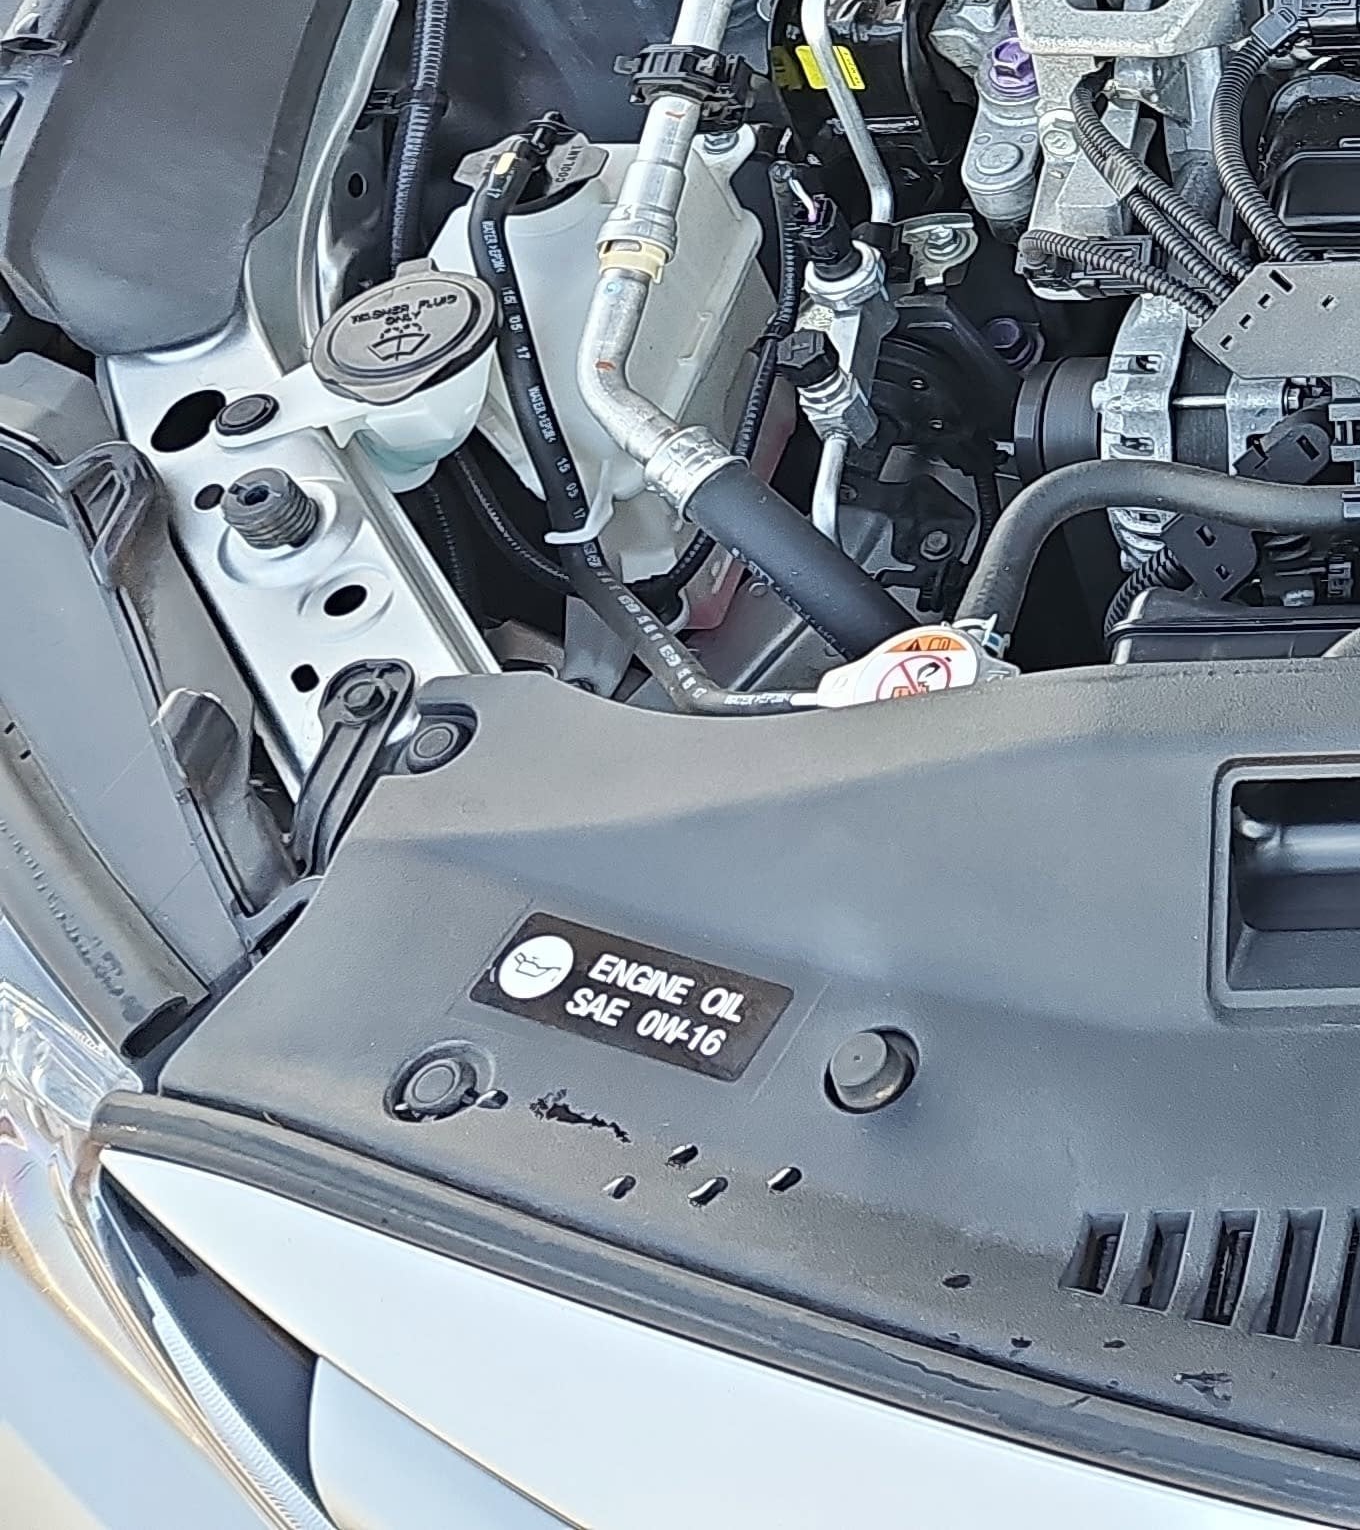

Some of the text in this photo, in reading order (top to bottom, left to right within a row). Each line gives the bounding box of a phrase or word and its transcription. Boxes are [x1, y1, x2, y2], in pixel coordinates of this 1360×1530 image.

[555, 145, 584, 183] COOLANT
[564, 986, 727, 1058] SAE 0W-16
[587, 951, 748, 1025] ENGINE OIL
